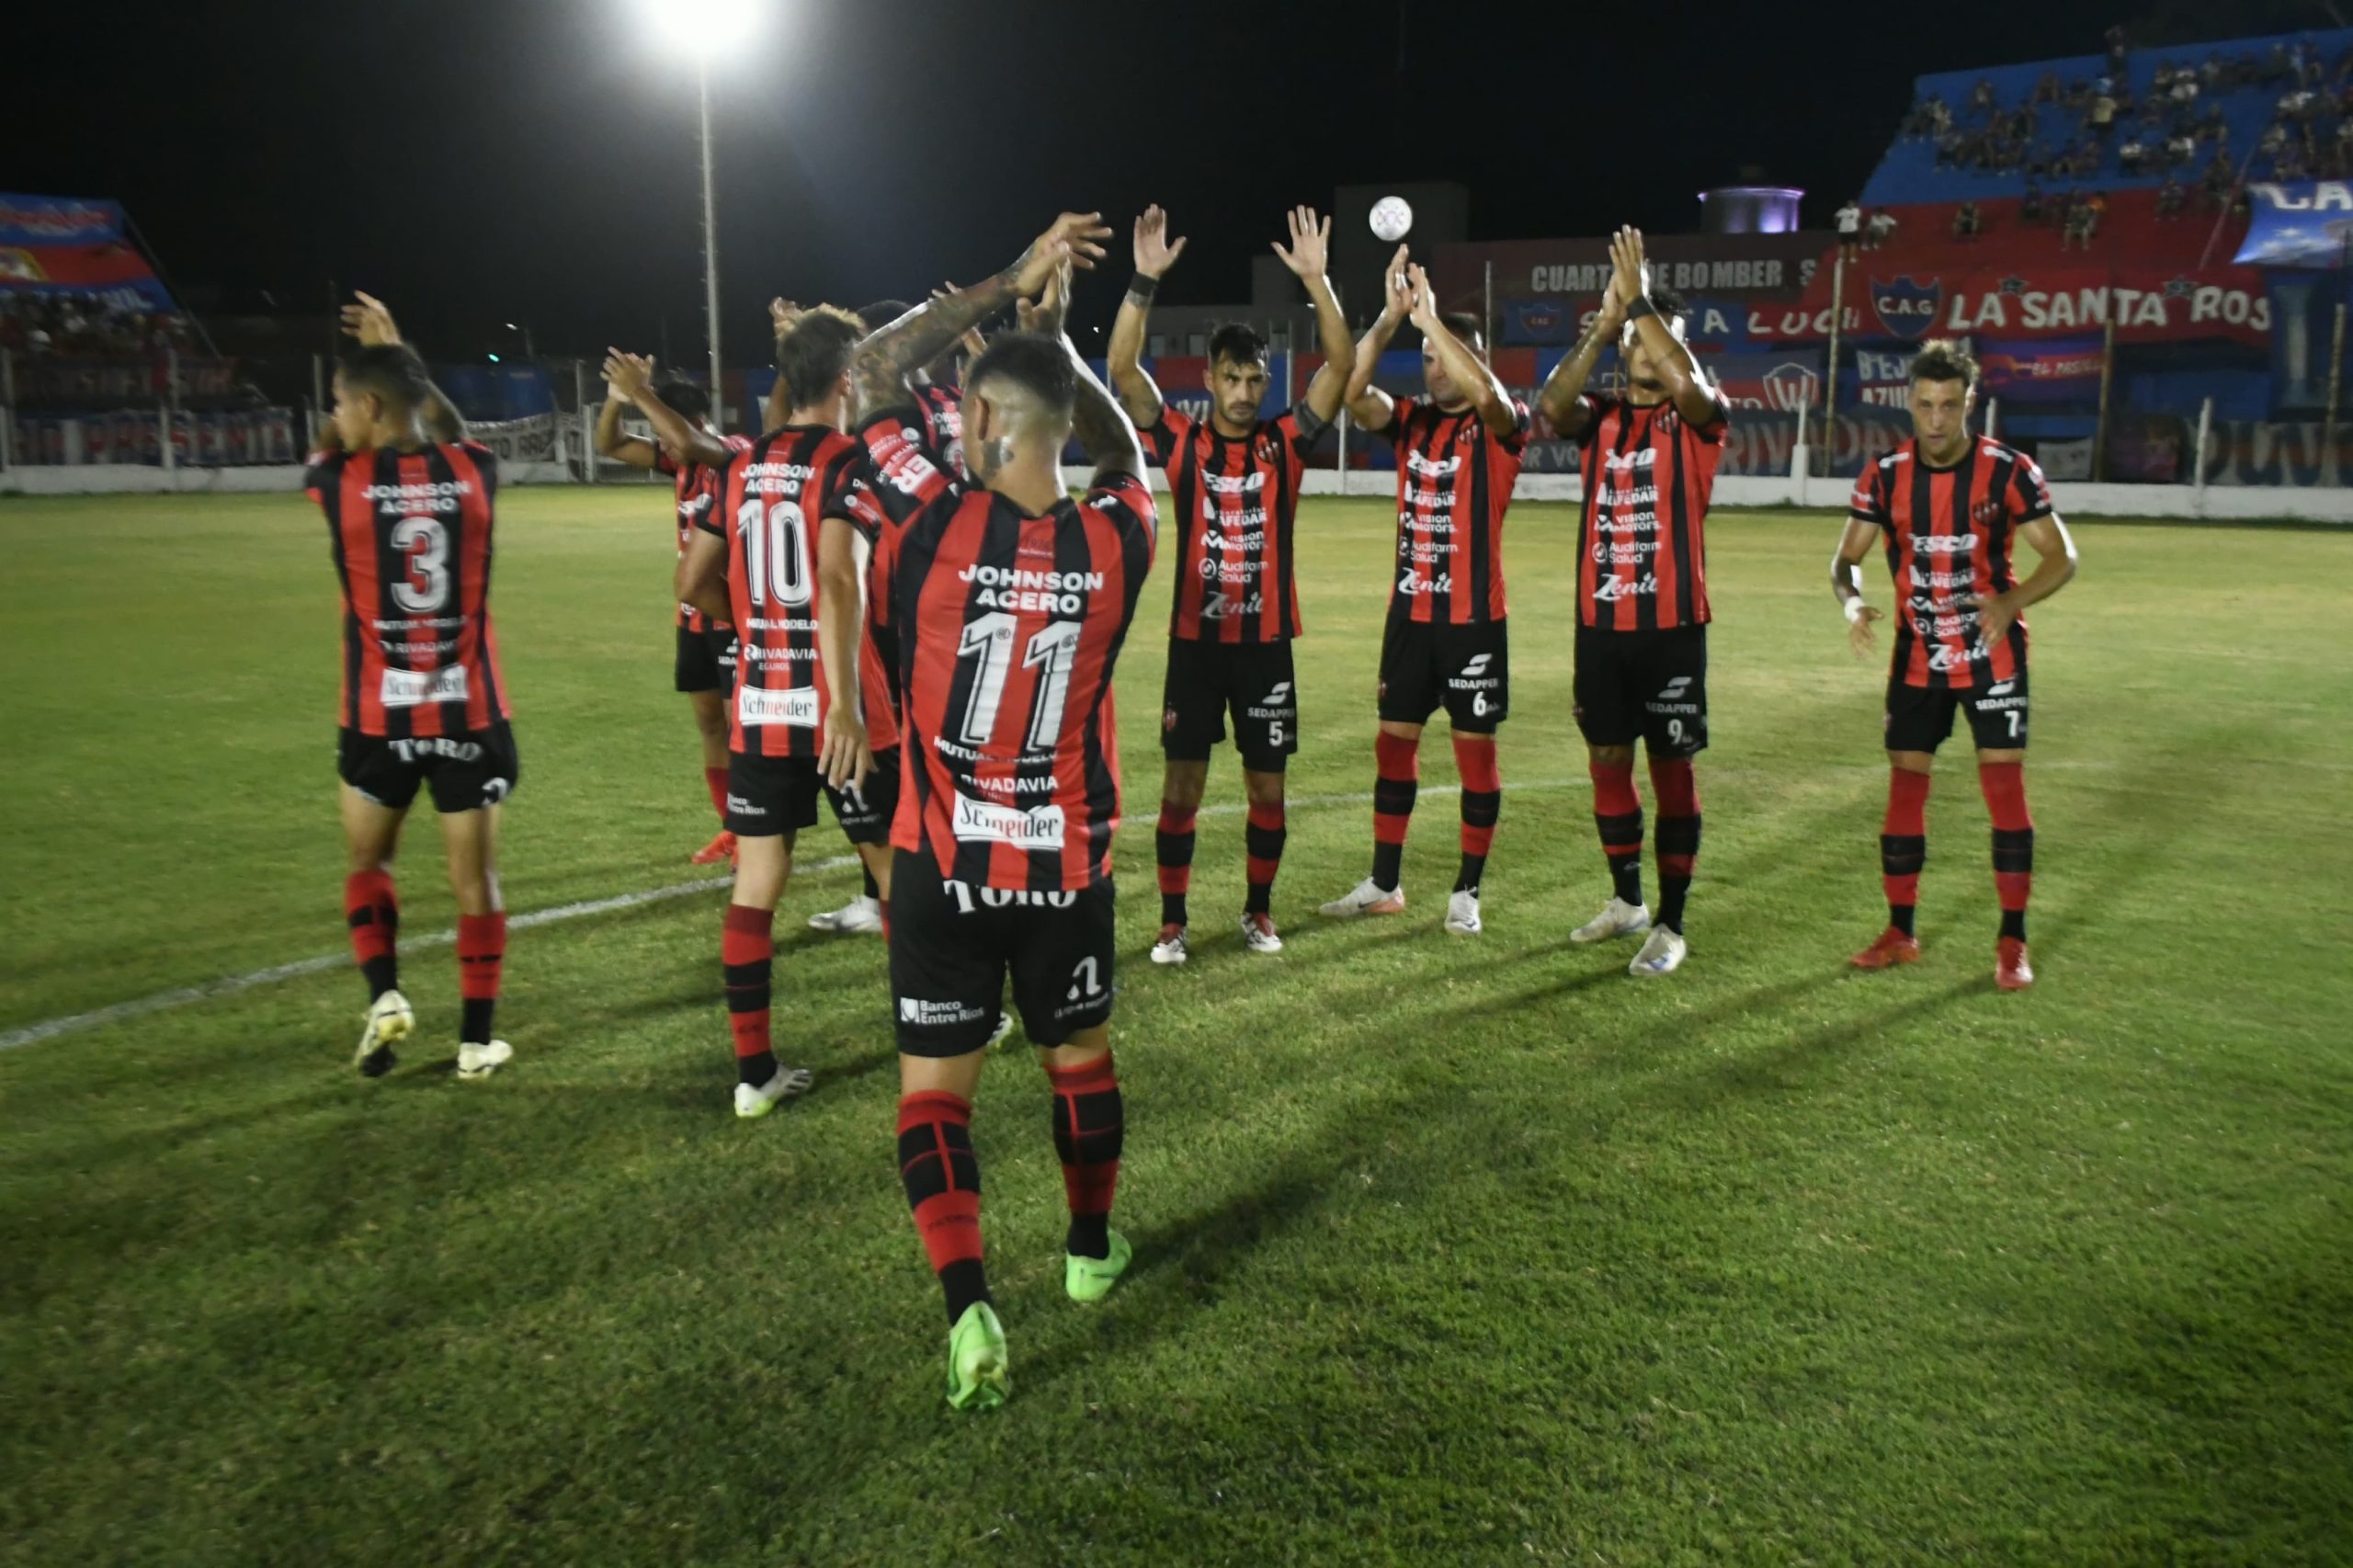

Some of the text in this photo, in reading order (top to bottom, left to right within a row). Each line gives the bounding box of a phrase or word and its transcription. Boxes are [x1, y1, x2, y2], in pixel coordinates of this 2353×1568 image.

[1531, 264, 1613, 292] CUART
[1947, 292, 2006, 329] LA
[2021, 286, 2168, 328] SANTA
[740, 462, 815, 480] JOHNSON
[360, 481, 471, 500] JOHNSON
[745, 479, 800, 494] ACERO
[380, 497, 458, 514] ACERO
[390, 516, 449, 613] 3
[736, 499, 812, 607] 10
[1411, 552, 1438, 564] Salud
[1609, 552, 1643, 563] Salud
[958, 563, 1104, 593] JOHNSON
[1218, 571, 1251, 583] Salud
[1398, 567, 1452, 596] Zenit
[1593, 572, 1657, 601] Zenit
[975, 588, 1082, 614] ACERO
[1199, 591, 1264, 619] Zenit
[956, 611, 1082, 753] 11
[742, 694, 813, 717] Schneider
[1472, 691, 1487, 717] 6
[1268, 721, 1283, 746] 5
[1667, 719, 1683, 744] 9
[2005, 710, 2019, 737] 7
[920, 1000, 961, 1012] Banco
[920, 1012, 957, 1024] Entre
